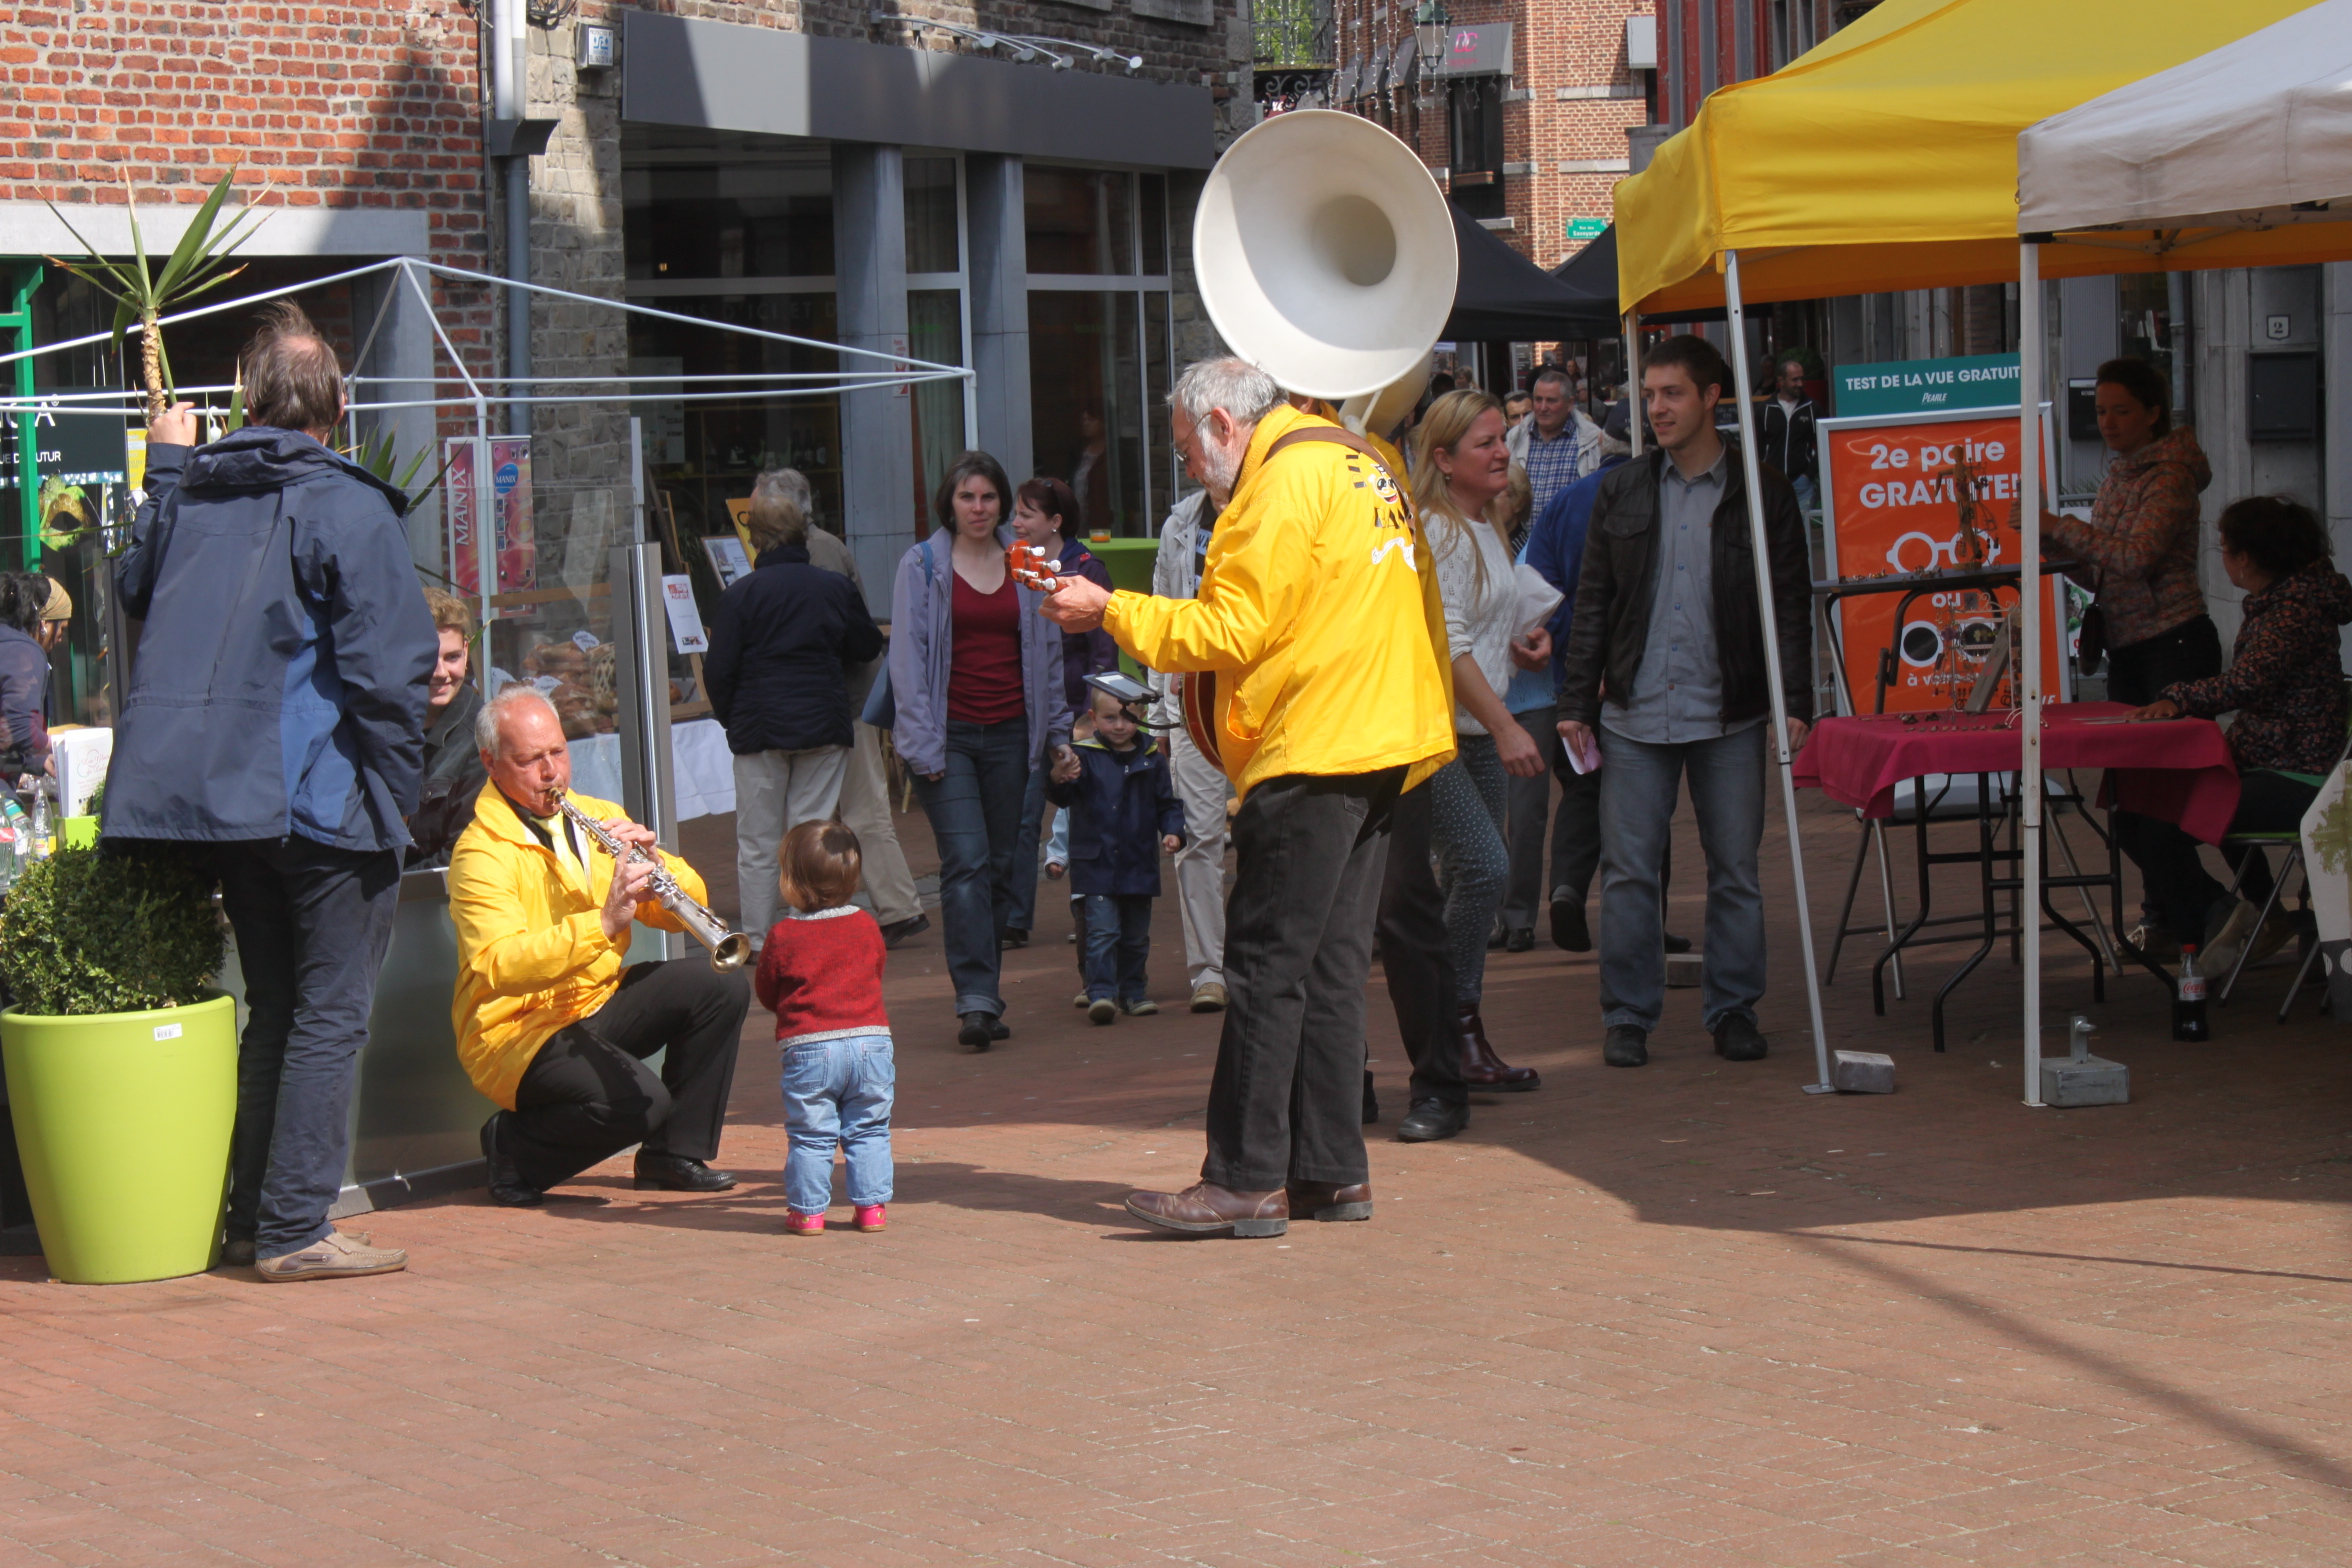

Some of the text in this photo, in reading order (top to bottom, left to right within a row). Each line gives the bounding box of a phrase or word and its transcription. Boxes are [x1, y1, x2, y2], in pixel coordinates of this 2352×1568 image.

[2274, 322, 2284, 334] 2
[1846, 366, 2020, 391] TEST DE LA VUE GRATUIT
[1870, 444, 1909, 470] 2e
[495, 475, 517, 484] MANIX
[452, 466, 469, 546] MANIX
[1931, 592, 1961, 608] ou
[1907, 672, 1918, 686] à
